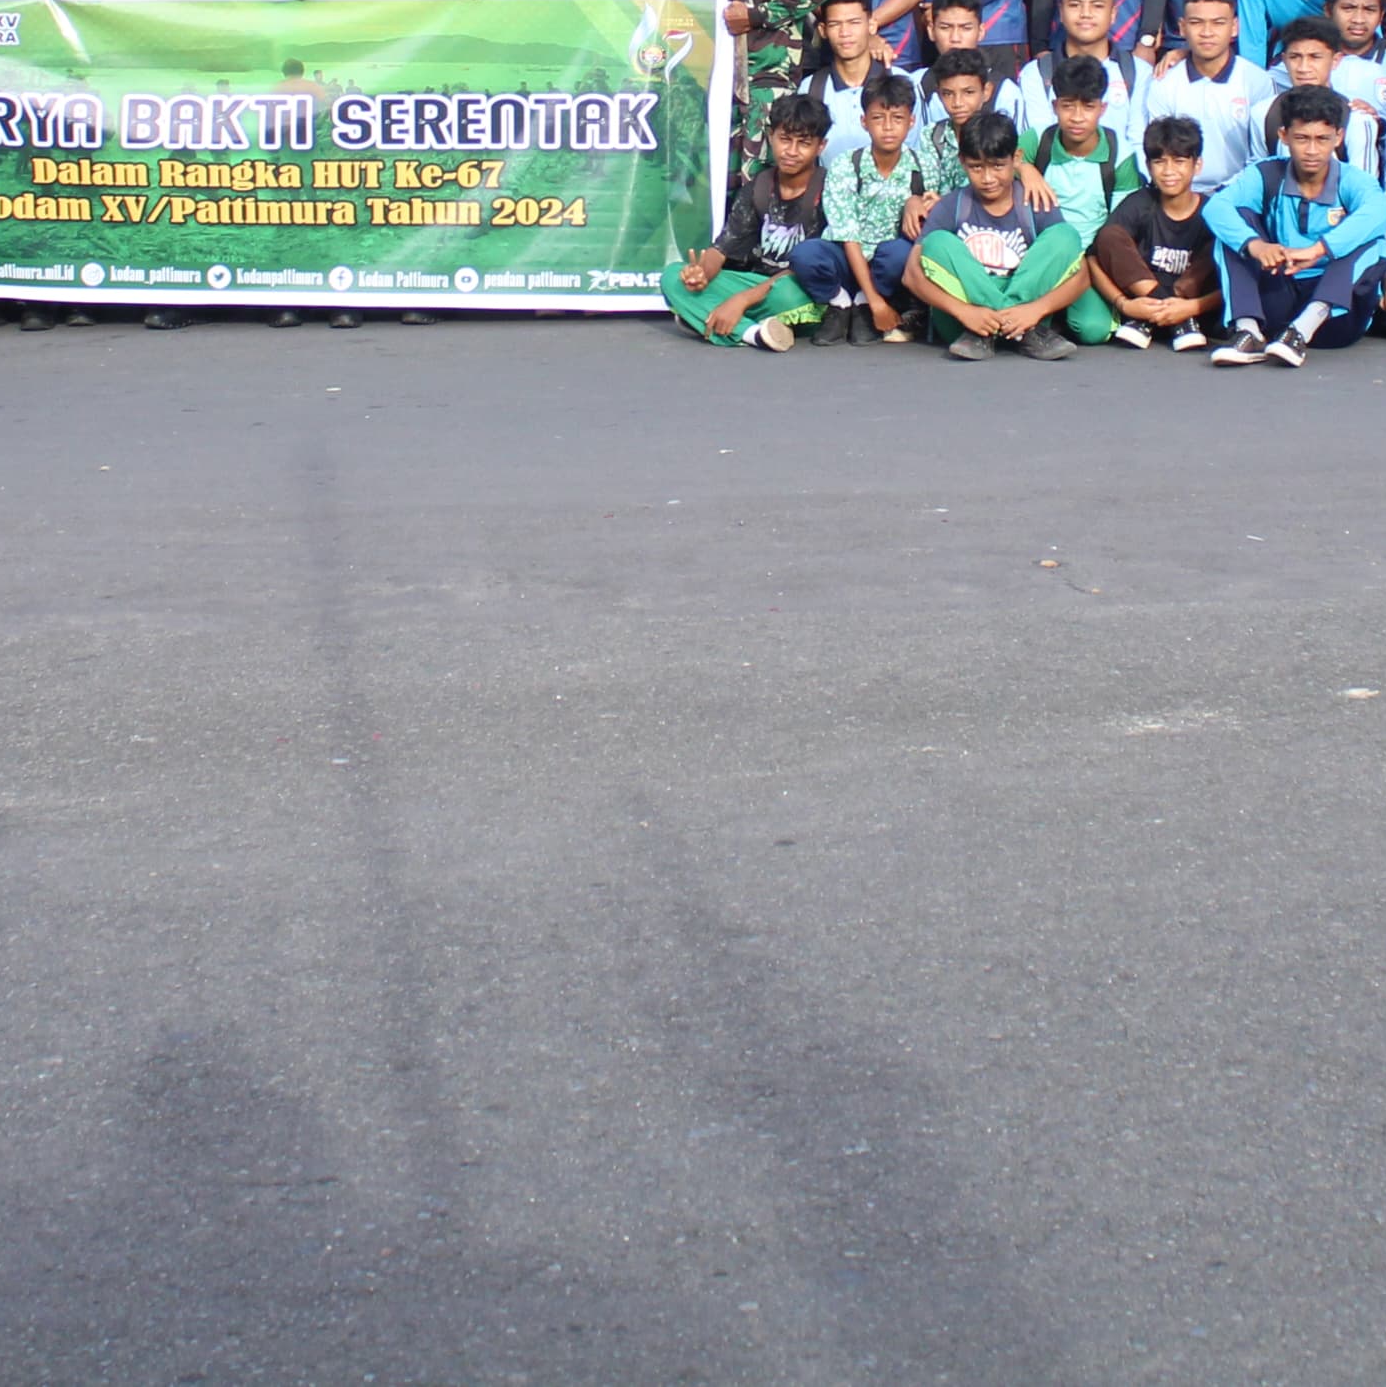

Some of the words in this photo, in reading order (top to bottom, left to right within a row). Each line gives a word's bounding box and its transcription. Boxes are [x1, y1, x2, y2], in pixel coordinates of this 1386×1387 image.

[121, 93, 314, 150] BAKTI
[332, 93, 658, 150] SERENTAK
[31, 157, 149, 188] Dalam
[159, 159, 302, 192] Rangka
[312, 160, 384, 190] HUT
[394, 160, 505, 190] Ke-67
[100, 194, 356, 226] XV/Pattimura
[366, 197, 481, 226] Tahun
[489, 197, 587, 227] 2024
[110, 264, 202, 285] kodam_pattimura
[236, 267, 324, 287] Kodampattimura
[358, 270, 394, 288] Kodam
[396, 270, 450, 289] Pattimura
[484, 270, 526, 289] pendam
[528, 270, 582, 290] pattimura
